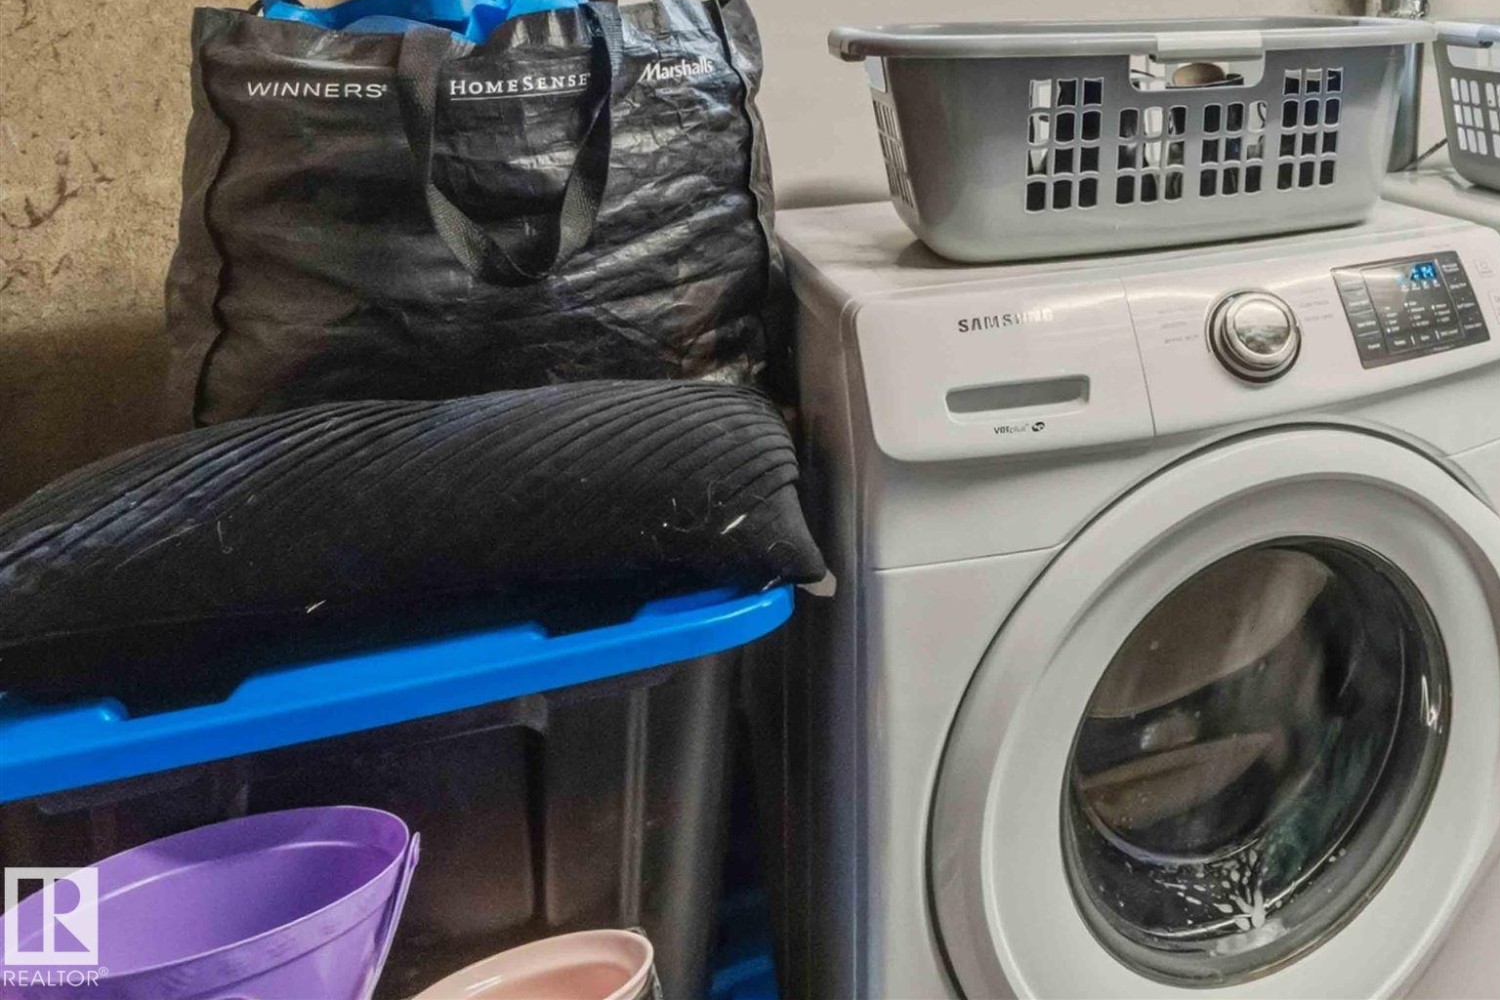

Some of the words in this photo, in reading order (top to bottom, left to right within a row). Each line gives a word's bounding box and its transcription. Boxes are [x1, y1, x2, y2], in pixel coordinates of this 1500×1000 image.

[638, 56, 714, 83] Marshalls
[247, 81, 383, 99] WINNERS
[957, 307, 1054, 333] SAMSUNG
